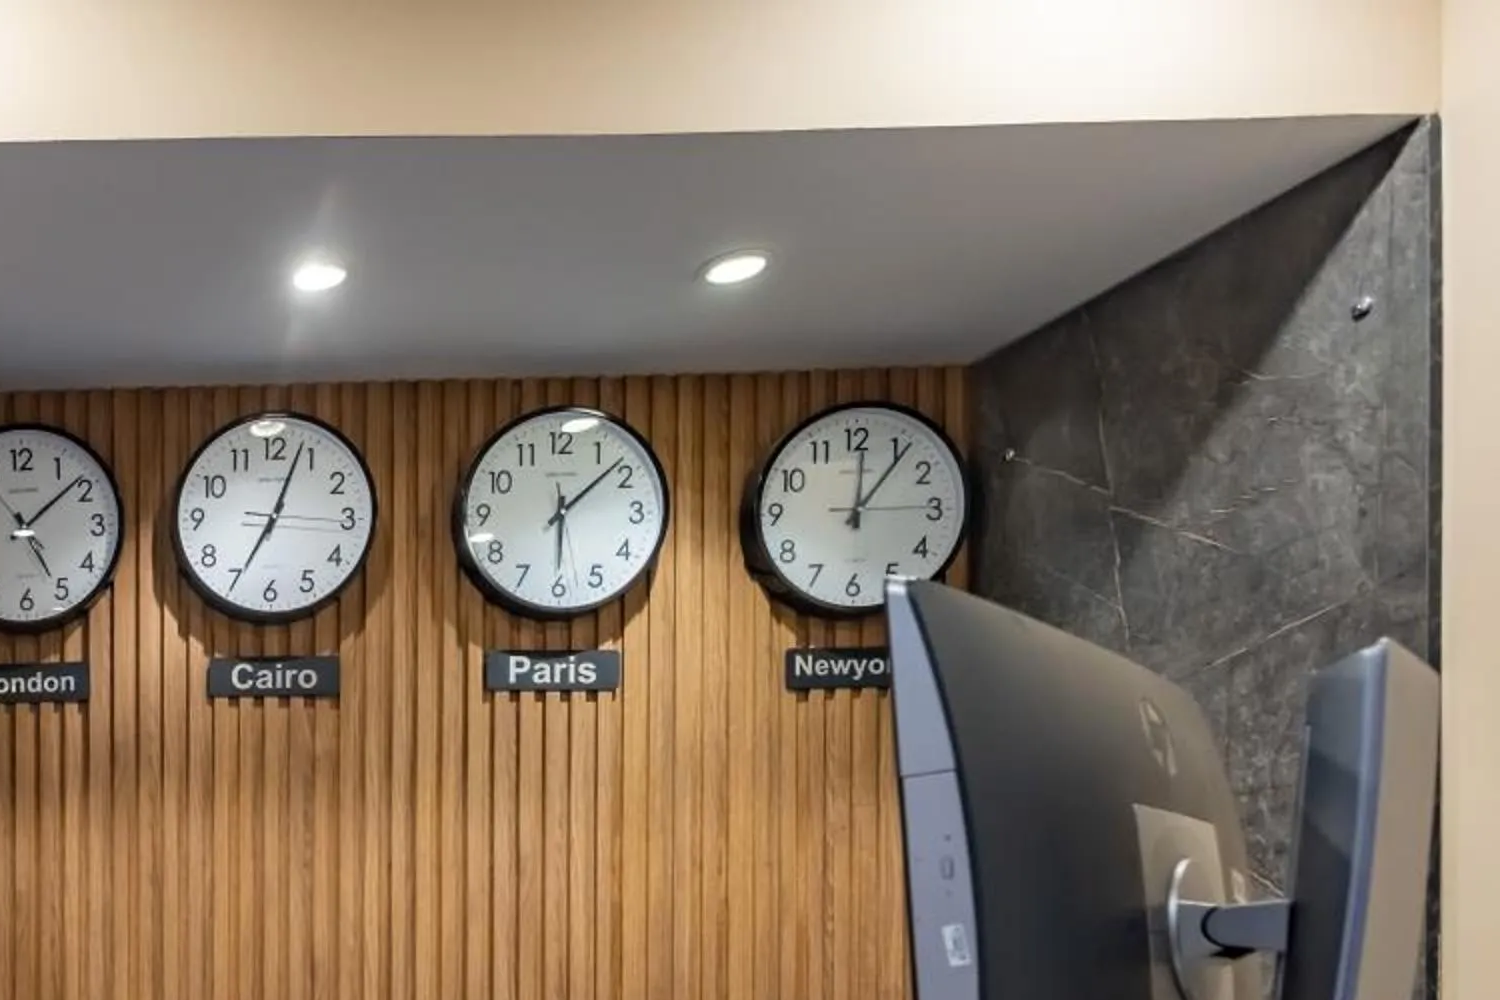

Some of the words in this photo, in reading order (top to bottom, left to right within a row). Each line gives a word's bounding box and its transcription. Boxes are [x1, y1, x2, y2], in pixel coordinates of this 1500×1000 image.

[263, 437, 287, 461] 12
[550, 432, 574, 455] 12
[844, 427, 869, 452] 12
[10, 447, 33, 472] 12
[231, 448, 249, 472] 11
[307, 447, 315, 471] 1
[517, 443, 535, 467] 11
[594, 441, 601, 465] 1
[809, 440, 829, 464] 11
[53, 457, 61, 480] 1
[618, 465, 634, 489] 2
[782, 468, 805, 493] 10
[915, 461, 931, 485] 2
[77, 479, 93, 503] 2
[203, 475, 227, 498] 10
[329, 471, 345, 495] 2
[489, 470, 513, 494] 10
[190, 508, 205, 531] 9
[340, 507, 356, 531] 3
[476, 503, 491, 526] 9
[629, 500, 645, 524] 3
[768, 503, 783, 526] 9
[925, 497, 943, 521] 3
[90, 513, 105, 537] 3
[201, 544, 217, 567] 8
[327, 544, 342, 567] 4
[487, 540, 503, 564] 8
[616, 538, 630, 561] 4
[779, 539, 795, 563] 8
[912, 535, 929, 558] 4
[78, 552, 94, 573] 4
[228, 569, 243, 592] 7
[300, 569, 315, 593] 5
[516, 564, 531, 588] 7
[551, 575, 566, 597] 6
[588, 565, 603, 588] 5
[808, 563, 824, 587] 7
[846, 573, 860, 597] 6
[19, 588, 34, 611] 6
[54, 577, 69, 601] 5
[263, 579, 277, 602] 6
[231, 663, 317, 690] Cairo
[508, 655, 597, 684] Paris
